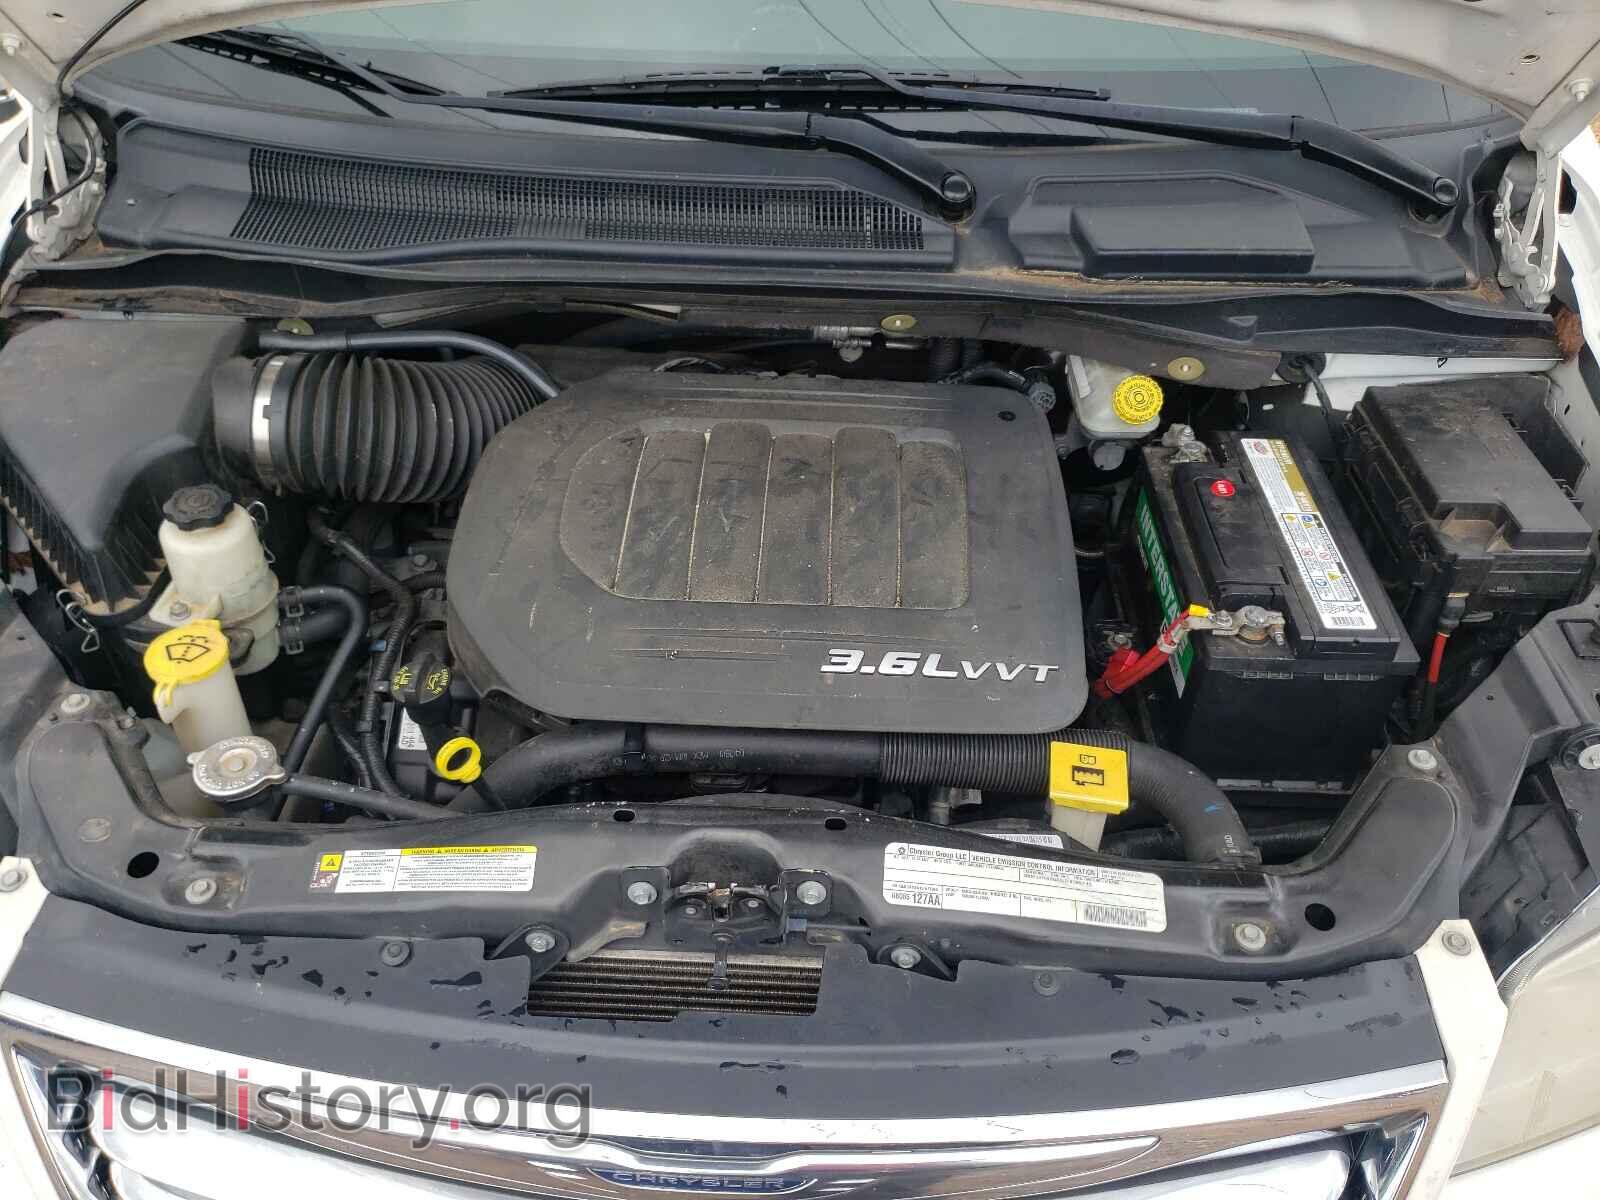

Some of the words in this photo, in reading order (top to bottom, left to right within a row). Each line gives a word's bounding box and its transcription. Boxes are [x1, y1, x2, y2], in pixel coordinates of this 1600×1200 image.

[820, 648, 960, 678] 3.6L
[960, 660, 1060, 683] VVT
[935, 850, 954, 860] Group
[955, 851, 968, 860] LLC
[970, 854, 995, 864] VEHICLE
[997, 857, 1026, 868] EMISSION
[1026, 862, 1054, 871] CONTROL
[911, 893, 941, 906] 127AA
[612, 1172, 785, 1189] CHRYSLER
